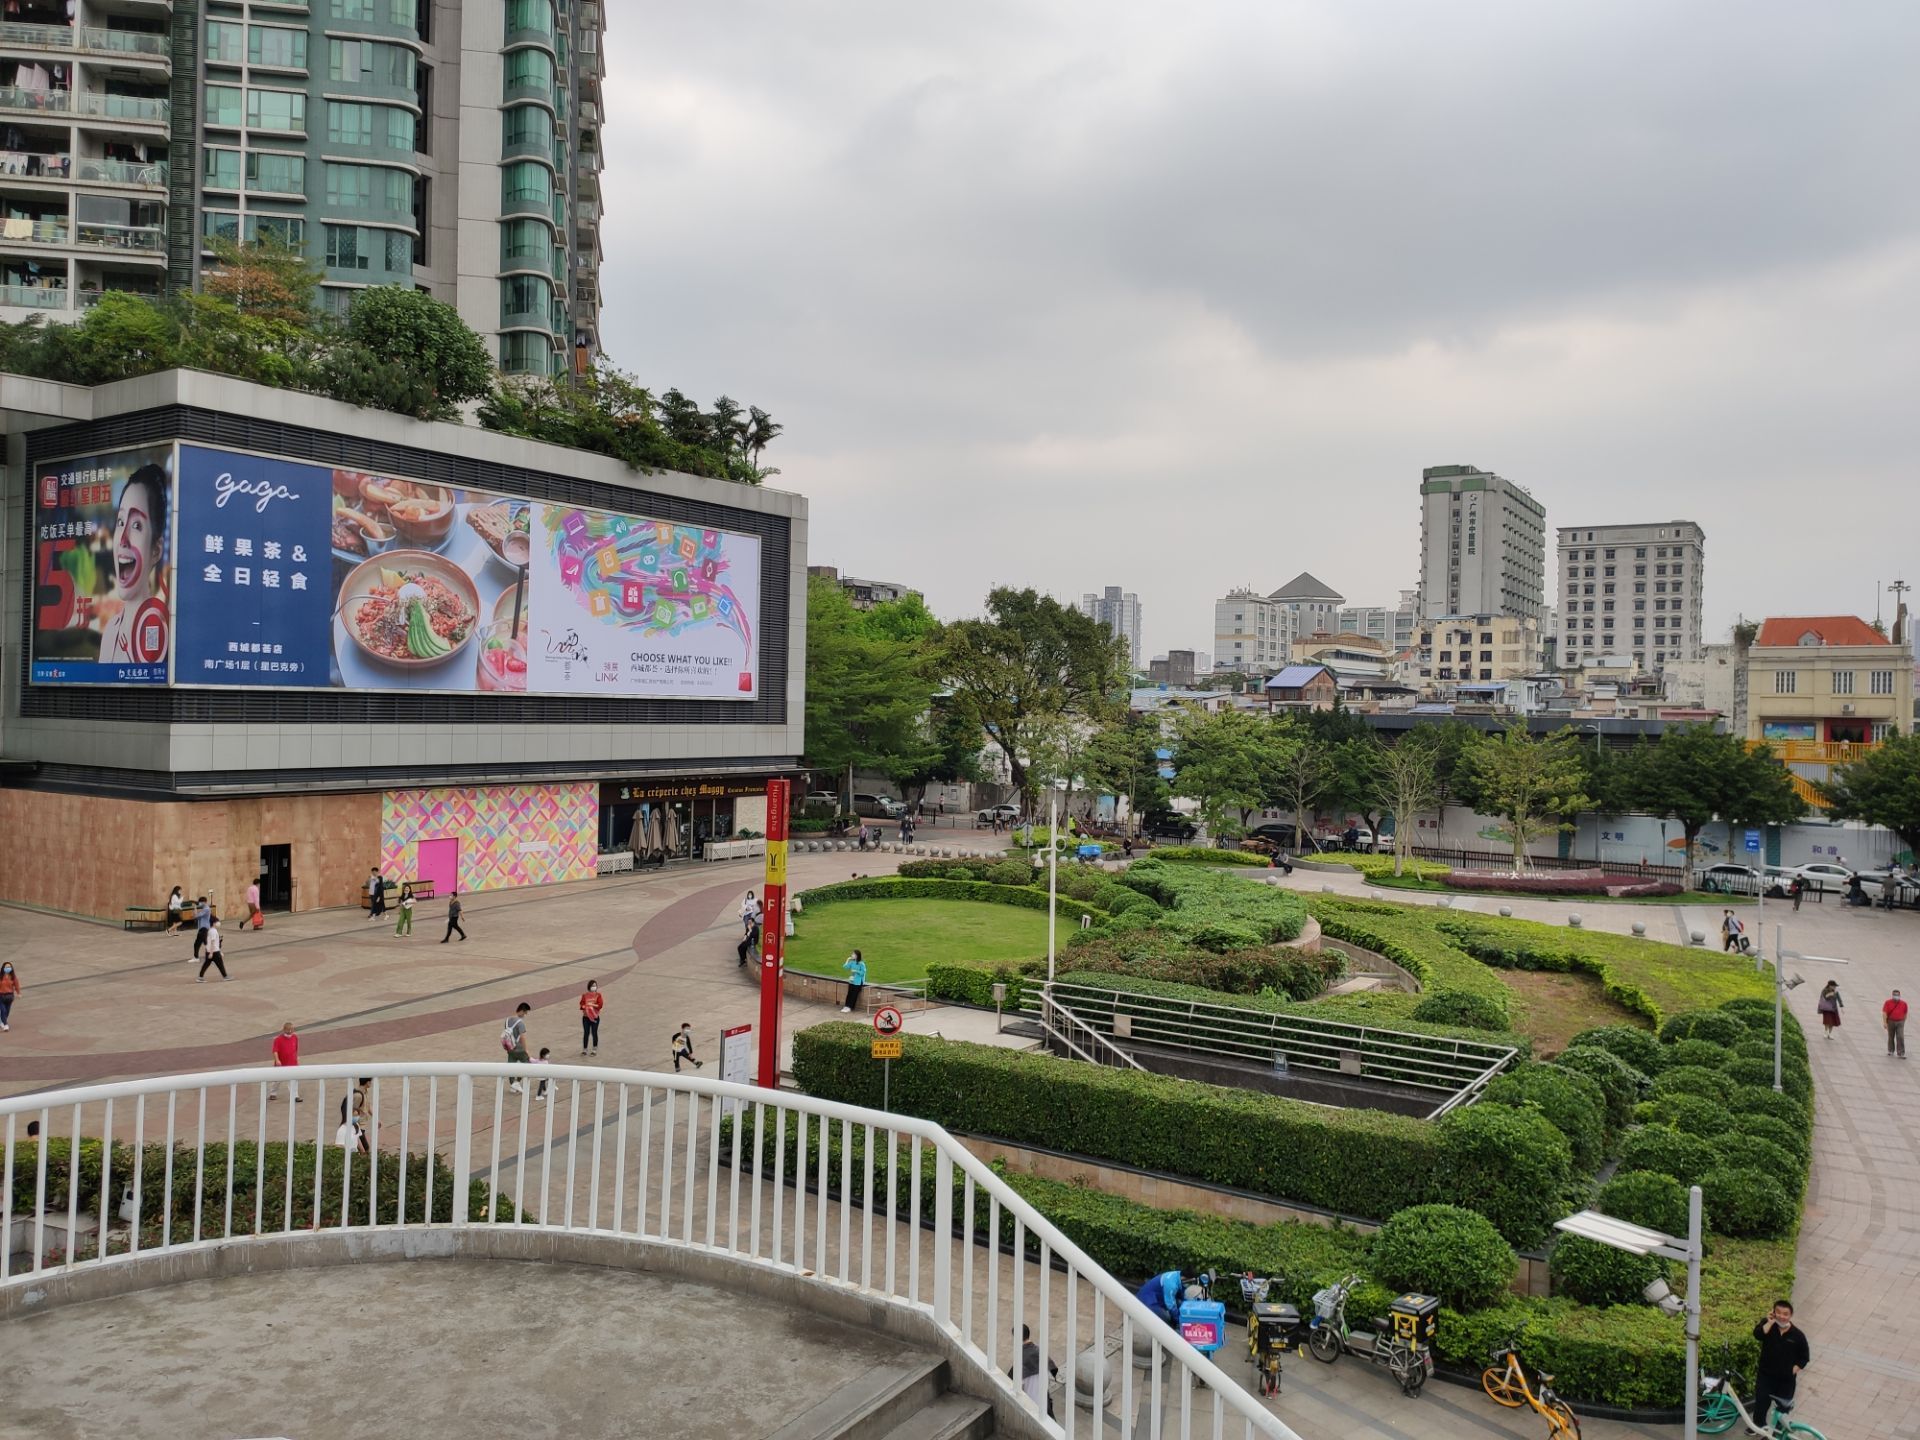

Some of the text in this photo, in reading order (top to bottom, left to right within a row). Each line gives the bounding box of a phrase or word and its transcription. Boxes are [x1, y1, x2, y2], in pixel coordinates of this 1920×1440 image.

[60, 467, 112, 486] 交通银行信用卡
[215, 472, 300, 513] gaga
[40, 521, 93, 540] 吃饭买单最高
[204, 563, 308, 590] 全日轻食
[630, 652, 732, 666] CHOOSE WHAT YOU LIKE!!
[595, 672, 618, 682] LINK
[632, 787, 644, 798] La
[681, 787, 696, 797] chez
[700, 784, 724, 796] Maggy
[771, 786, 779, 832] Huangsha
[1601, 832, 1624, 841] 文明
[768, 899, 775, 911] F
